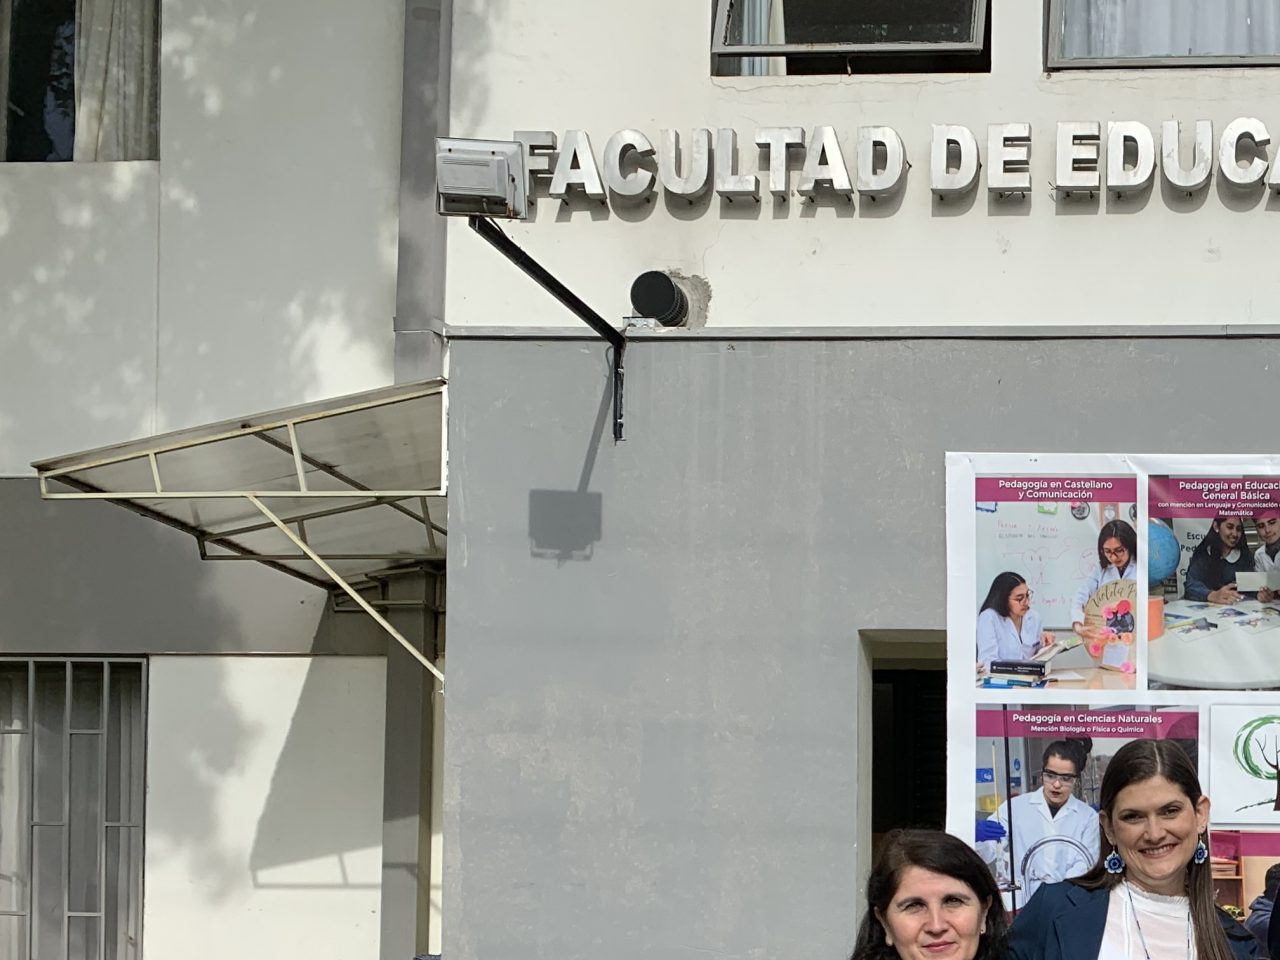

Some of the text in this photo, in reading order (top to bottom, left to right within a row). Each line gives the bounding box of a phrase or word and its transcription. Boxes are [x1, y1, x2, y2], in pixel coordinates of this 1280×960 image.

[513, 125, 908, 199] FACULTAD
[931, 122, 1033, 194] DE
[999, 480, 1048, 490] Pedagogía
[1064, 480, 1112, 489] Castellano
[1179, 482, 1228, 492] Pedagogía
[1026, 490, 1093, 498] Comunicación
[1202, 491, 1270, 500] General Básica
[1012, 714, 1061, 724] Pedagogía
[1078, 714, 1116, 723] Ciencias
[1118, 715, 1162, 724] Naturales
